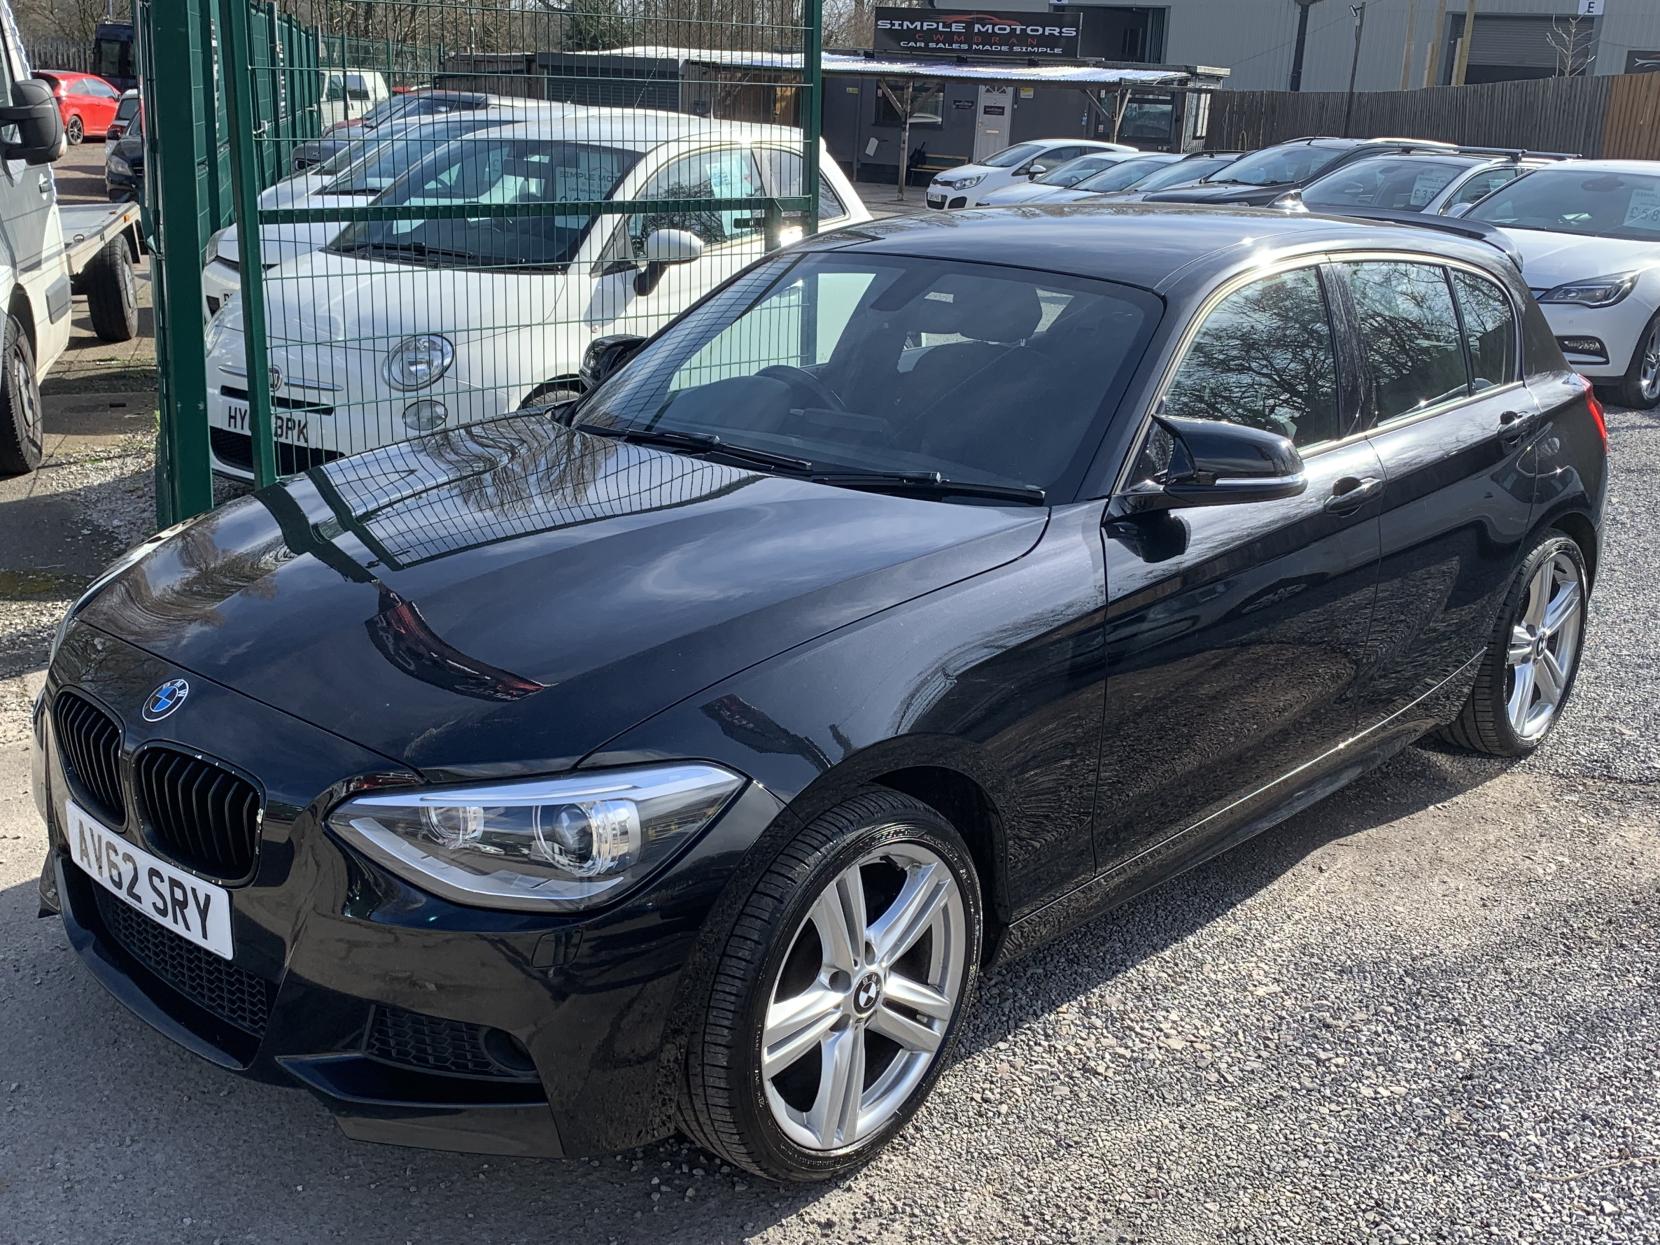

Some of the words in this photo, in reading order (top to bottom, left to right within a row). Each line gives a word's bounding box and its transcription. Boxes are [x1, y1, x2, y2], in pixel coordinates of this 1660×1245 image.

[1587, 1, 1595, 13] E
[877, 19, 966, 32] SIMPLE
[974, 23, 1077, 36] MOTORS
[915, 33, 1037, 45] CWMBRAN
[1013, 46, 1063, 54] SIMPLE
[78, 818, 143, 905] AV62
[147, 866, 211, 941] SRY
